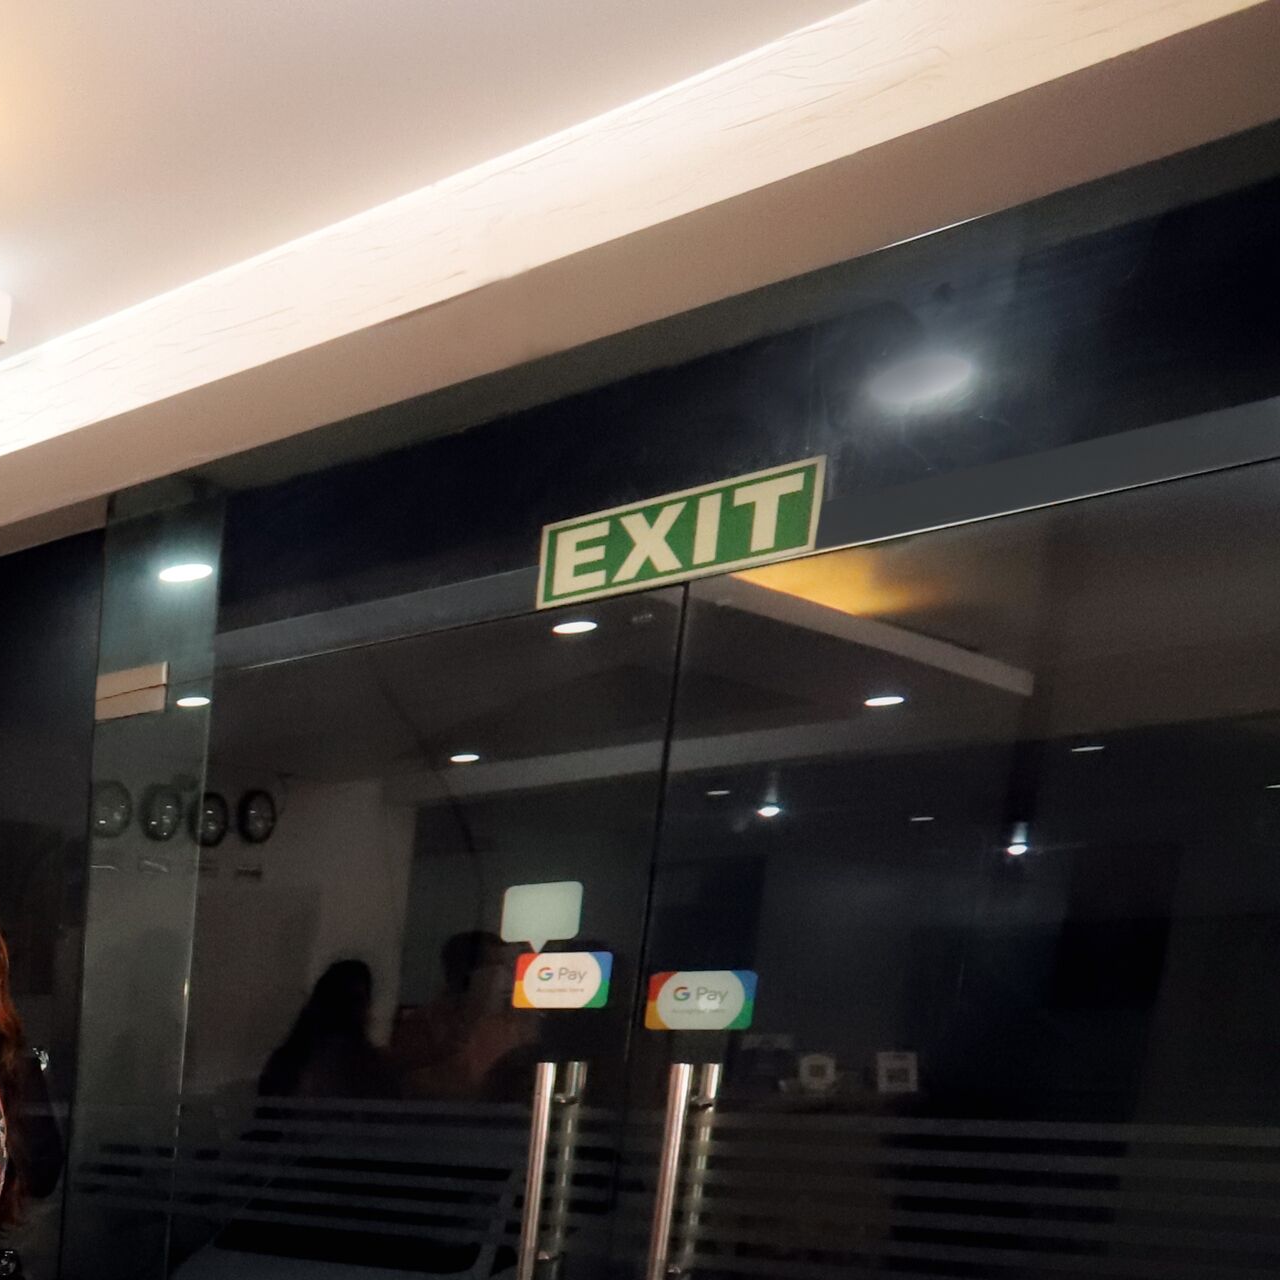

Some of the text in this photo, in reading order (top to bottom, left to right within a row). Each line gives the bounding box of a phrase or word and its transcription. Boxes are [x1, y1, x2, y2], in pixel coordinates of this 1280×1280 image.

[552, 472, 805, 597] EXIT
[537, 967, 588, 983] G Pay
[673, 986, 729, 1003] G Pay
